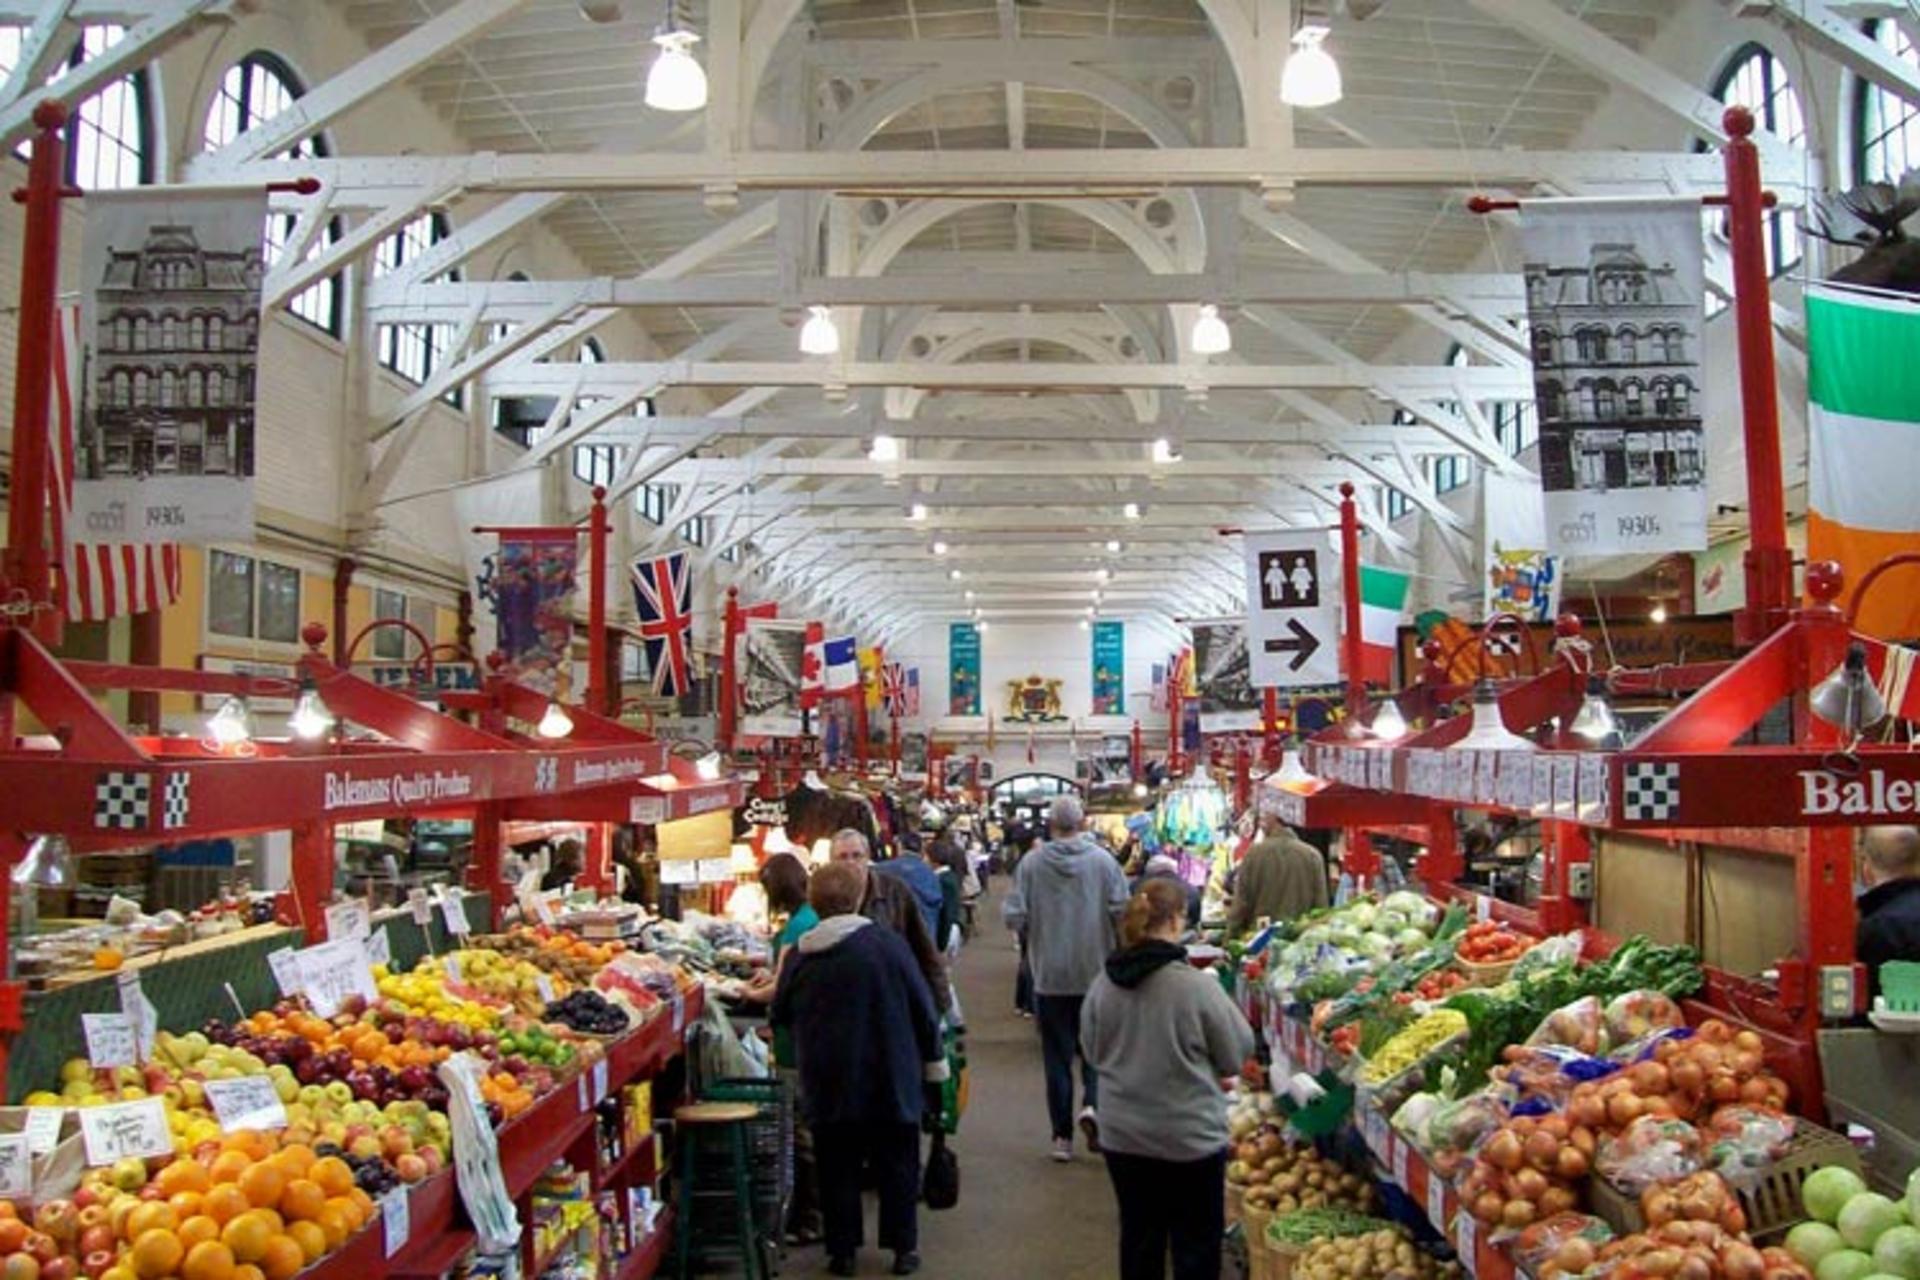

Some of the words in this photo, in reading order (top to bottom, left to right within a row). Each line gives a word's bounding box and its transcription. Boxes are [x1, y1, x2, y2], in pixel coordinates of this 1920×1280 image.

[325, 772, 391, 810] Balemans
[392, 772, 432, 808] Quality
[1796, 769, 1920, 815] Bale
